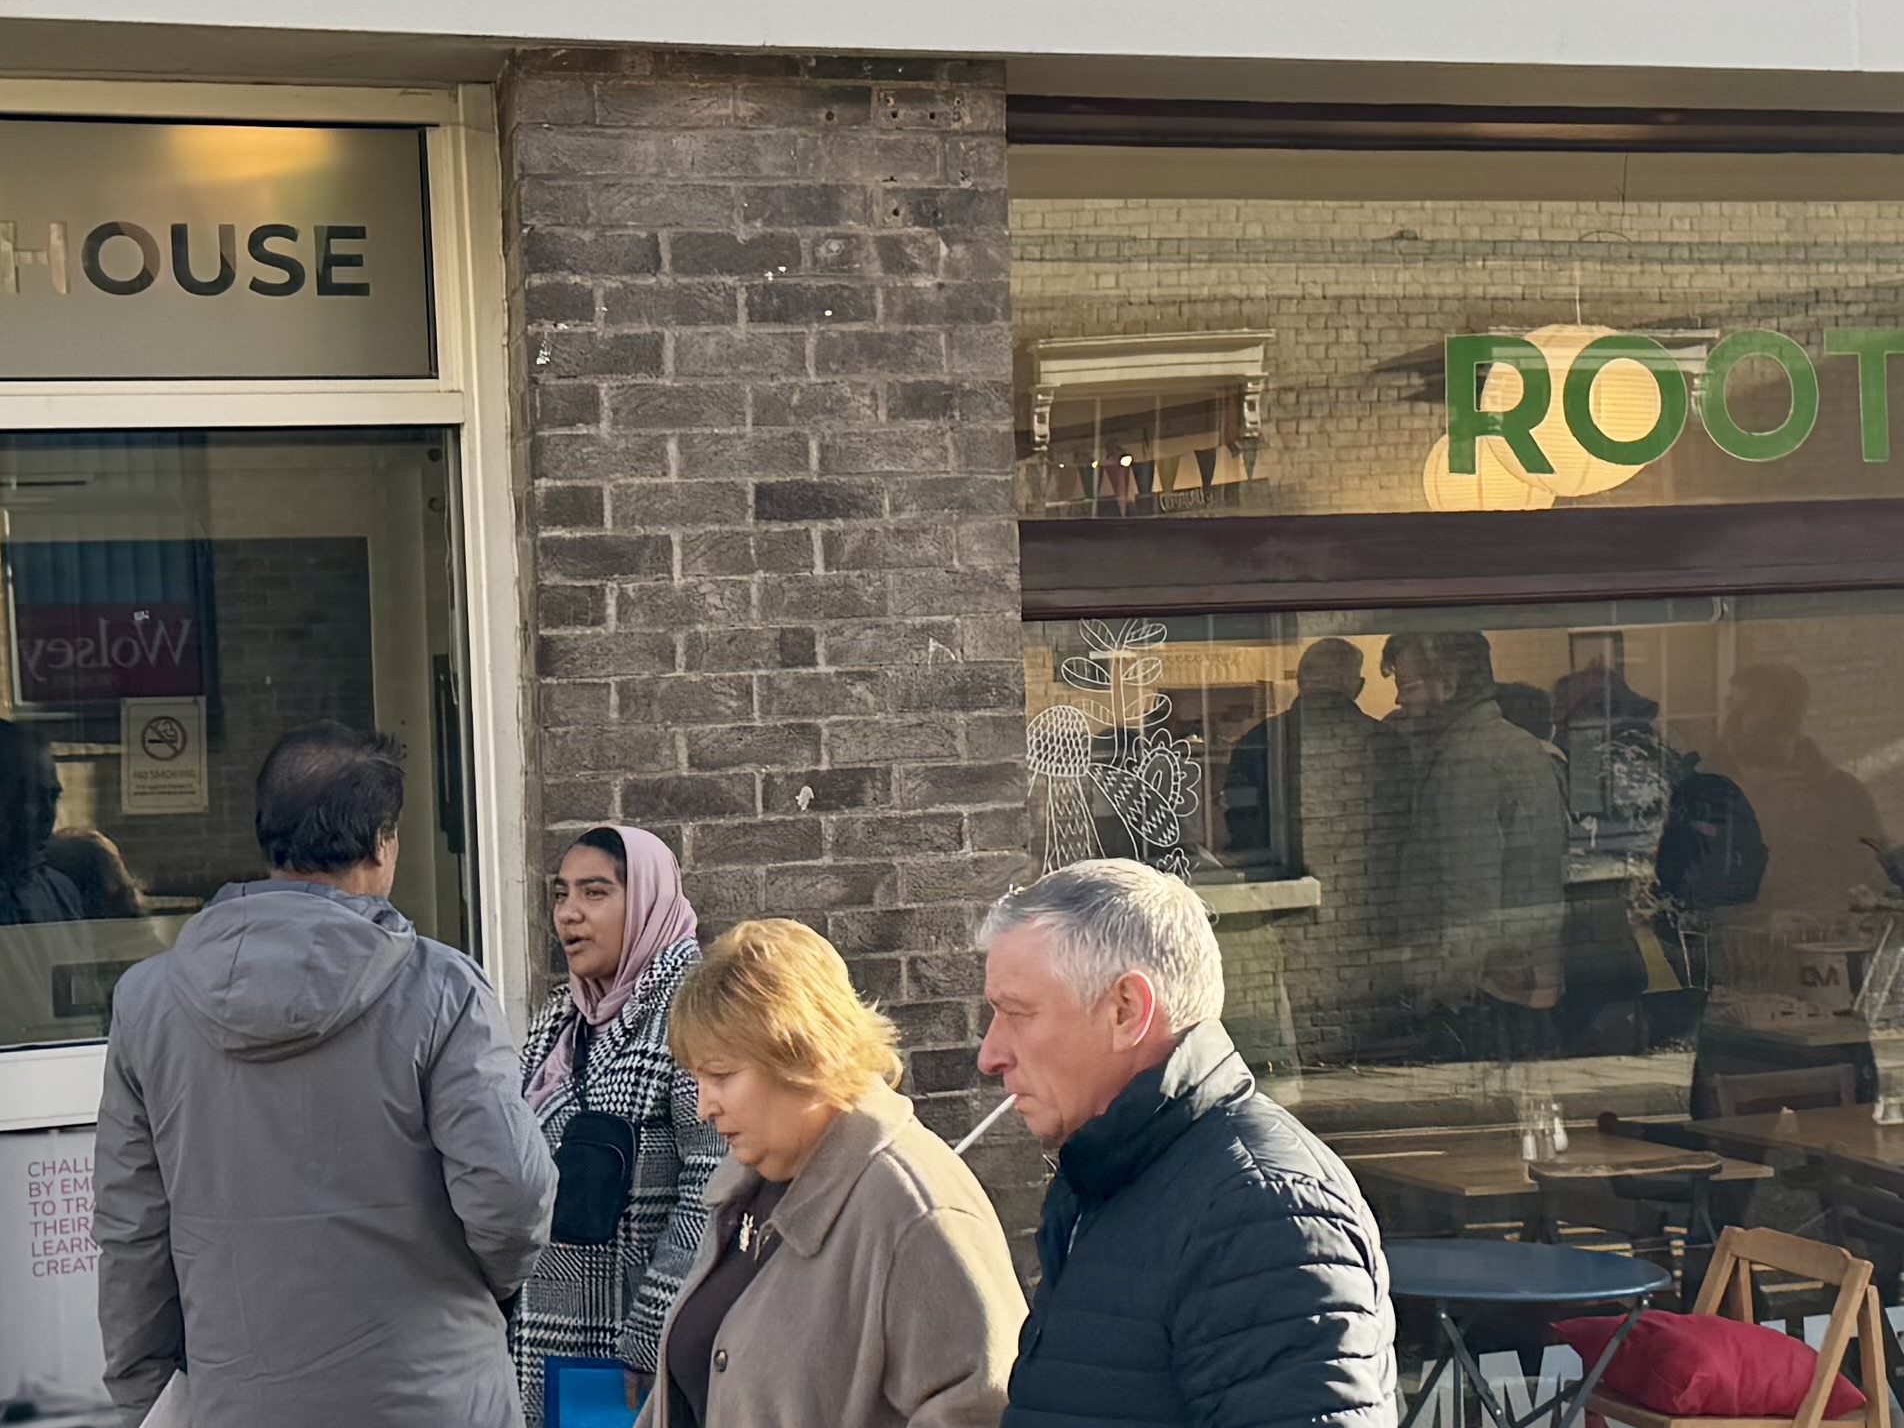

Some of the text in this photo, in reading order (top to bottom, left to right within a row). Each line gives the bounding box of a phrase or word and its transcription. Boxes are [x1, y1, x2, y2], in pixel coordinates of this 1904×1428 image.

[0, 217, 372, 299] HOUSE
[28, 1180, 54, 1198] BY
[28, 1199, 57, 1218] TO
[29, 1216, 92, 1238] THEIR
